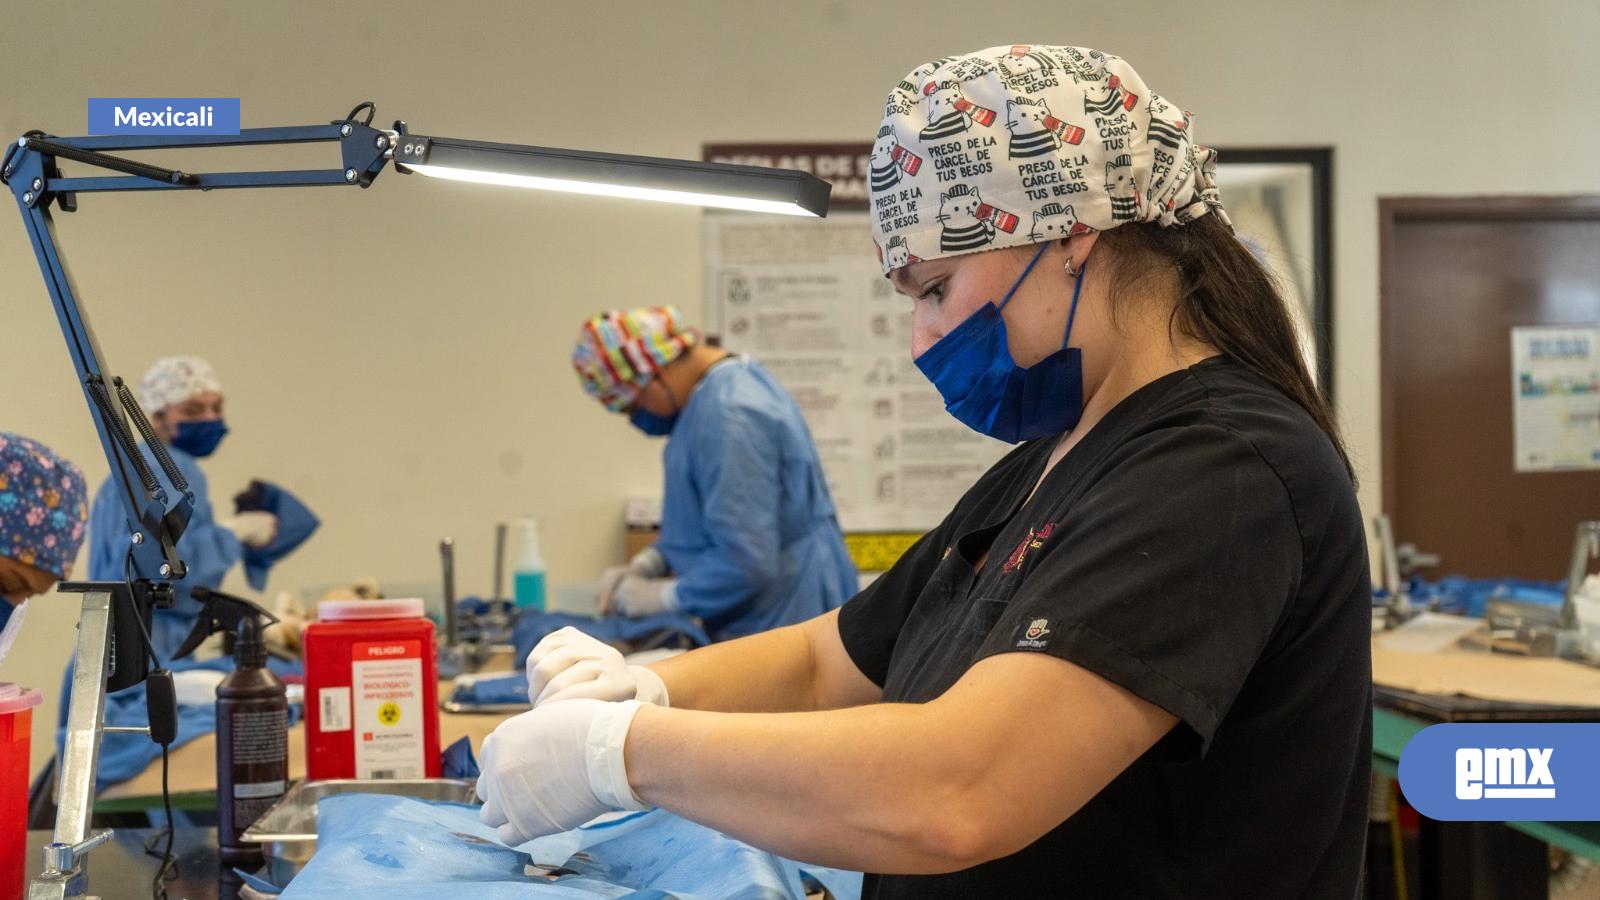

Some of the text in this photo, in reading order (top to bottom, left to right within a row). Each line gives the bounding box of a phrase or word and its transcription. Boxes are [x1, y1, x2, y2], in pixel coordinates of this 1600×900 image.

[1025, 77, 1059, 94] BESOS
[928, 136, 998, 158] PRESO DE LA
[1102, 138, 1124, 151] TUS
[976, 149, 991, 160] DE
[936, 162, 993, 182] TUS BESOS
[1018, 155, 1089, 176] PRESO DE LA
[1069, 169, 1084, 180] DE
[875, 187, 922, 210] PRESO DE LA
[1025, 182, 1089, 201] TUS BESOS
[907, 201, 918, 212] DE
[880, 214, 920, 234] TUS BESOS
[368, 646, 406, 656] PELIGRO
